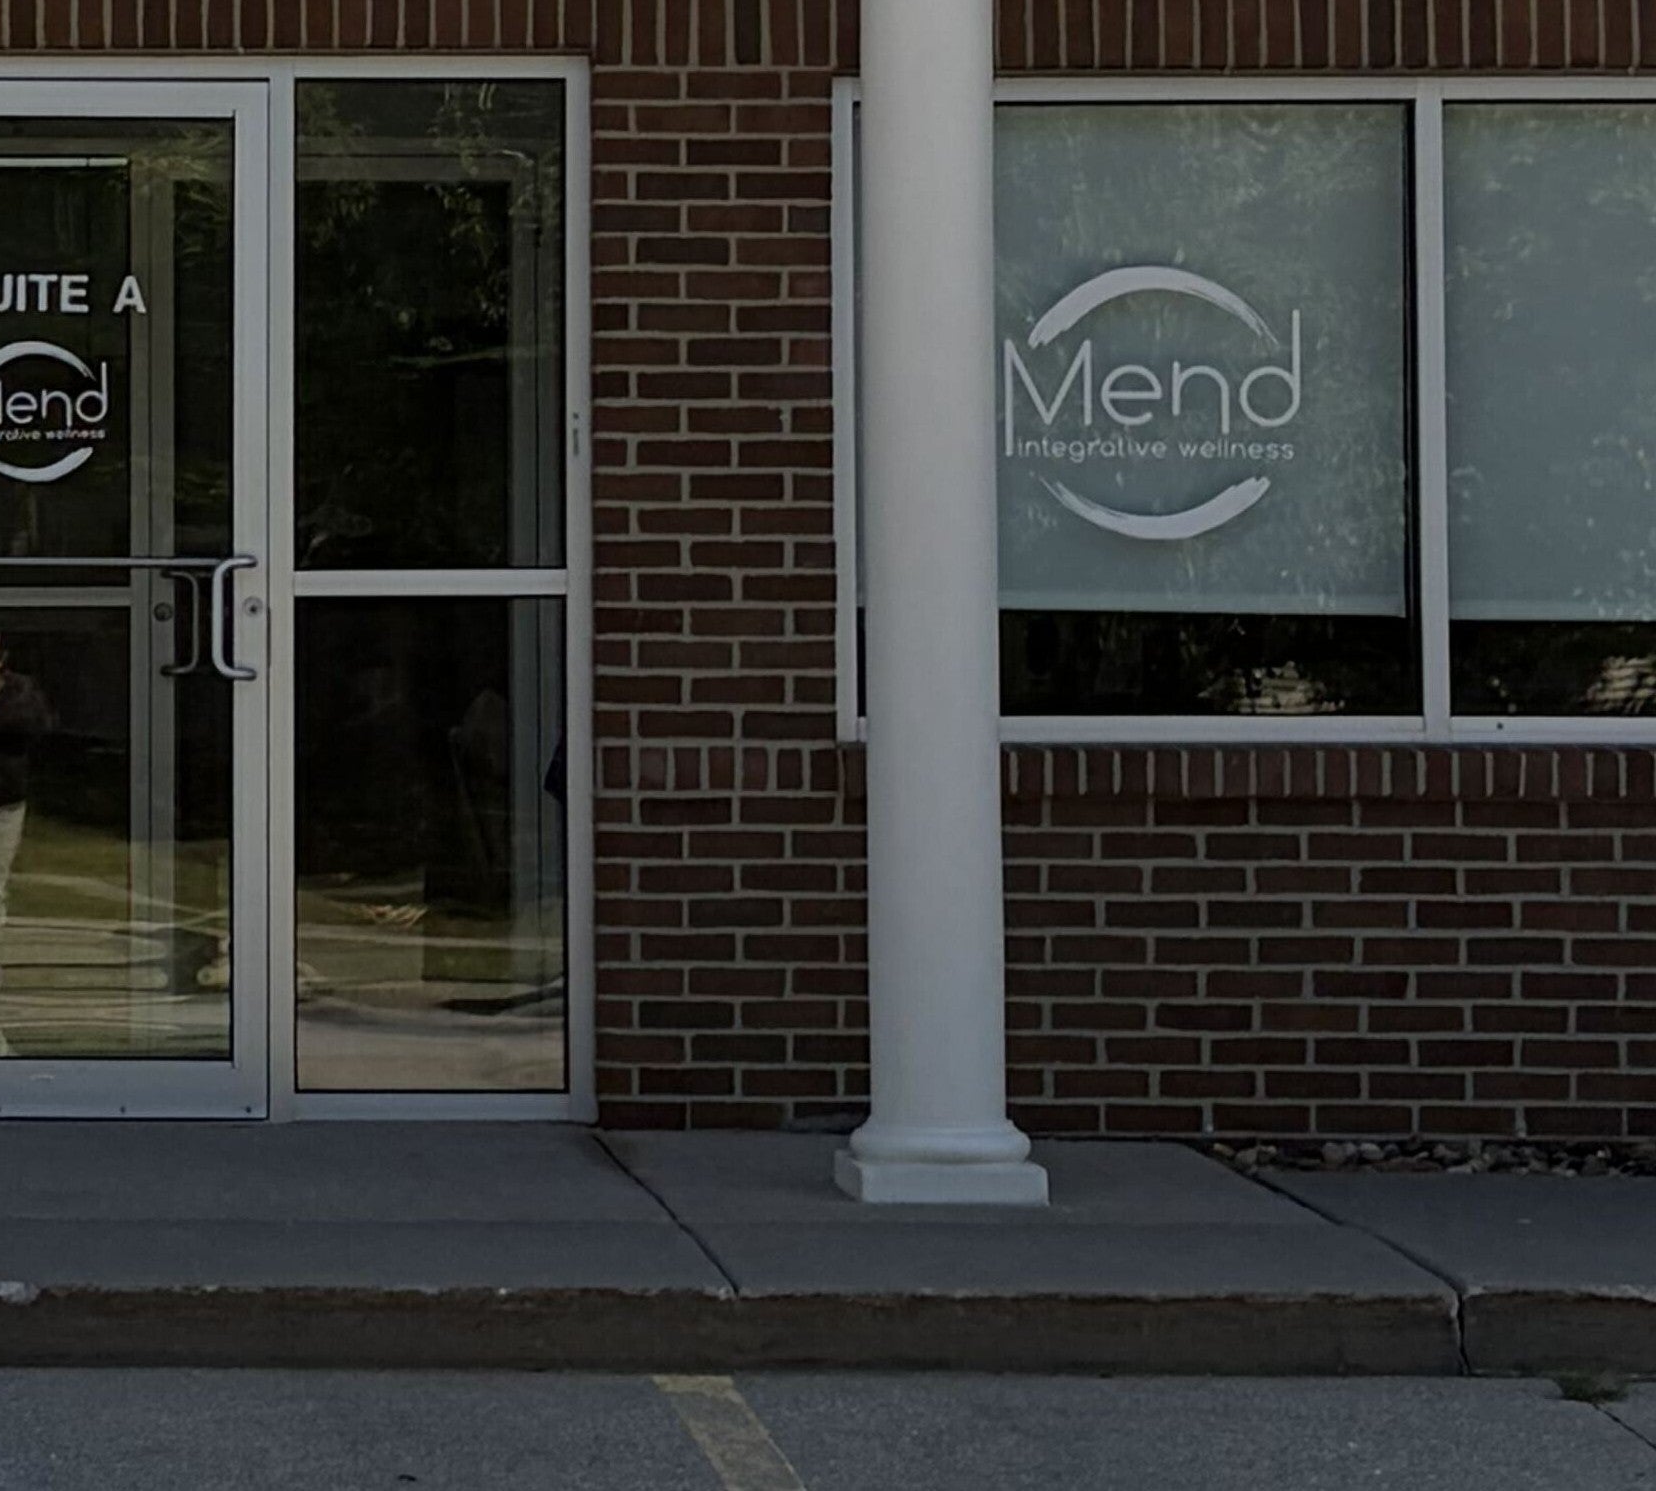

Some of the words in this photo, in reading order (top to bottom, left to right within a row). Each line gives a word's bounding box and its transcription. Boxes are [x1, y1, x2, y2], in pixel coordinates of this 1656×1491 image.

[112, 274, 147, 314] A
[1003, 308, 1301, 457] Mend
[1016, 437, 1168, 463] integrative
[1178, 438, 1295, 460] wellness
